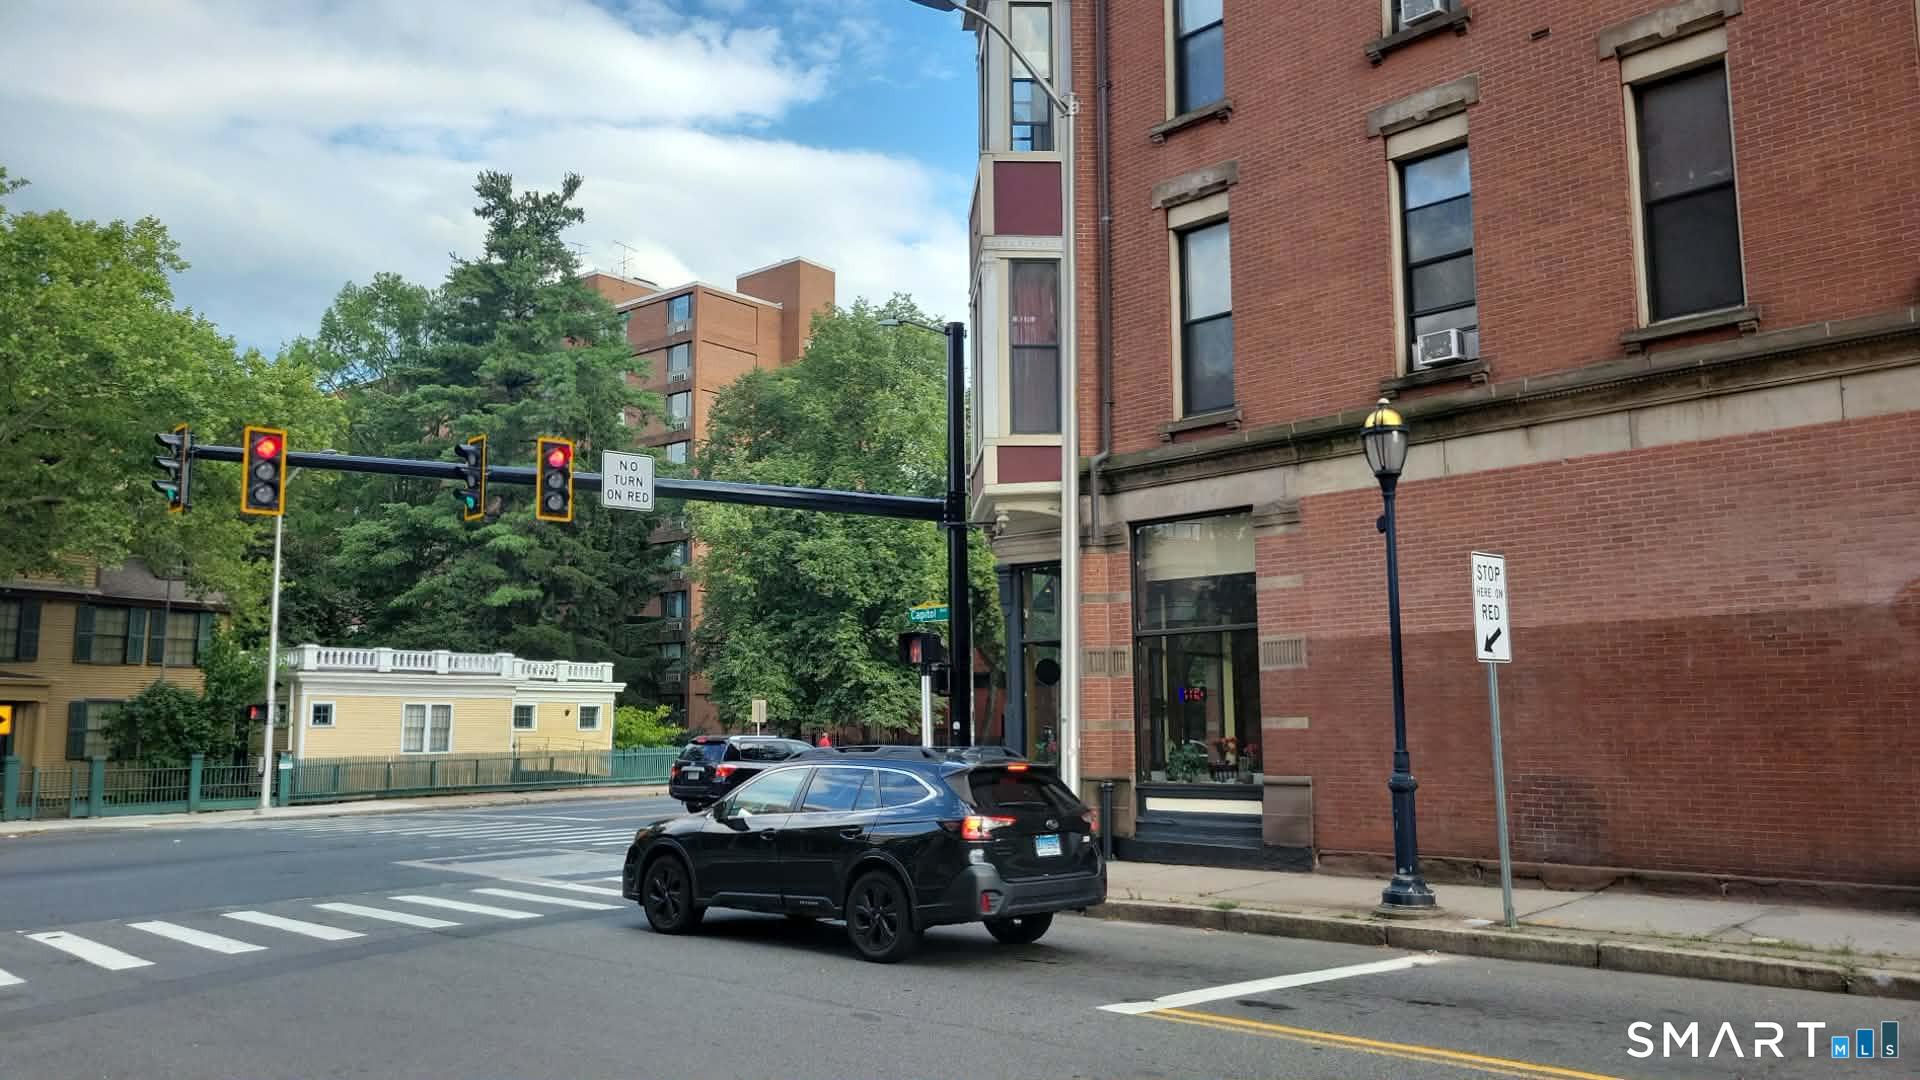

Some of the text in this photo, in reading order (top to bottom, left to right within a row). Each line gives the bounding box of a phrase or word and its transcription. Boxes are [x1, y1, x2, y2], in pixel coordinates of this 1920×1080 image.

[620, 460, 638, 472] NO
[614, 474, 643, 487] TURN
[607, 489, 649, 503] ON RED
[1477, 564, 1500, 582] STOP
[1477, 586, 1503, 599] HERE ON
[911, 608, 937, 622] Capitol
[1482, 603, 1500, 621] RED
